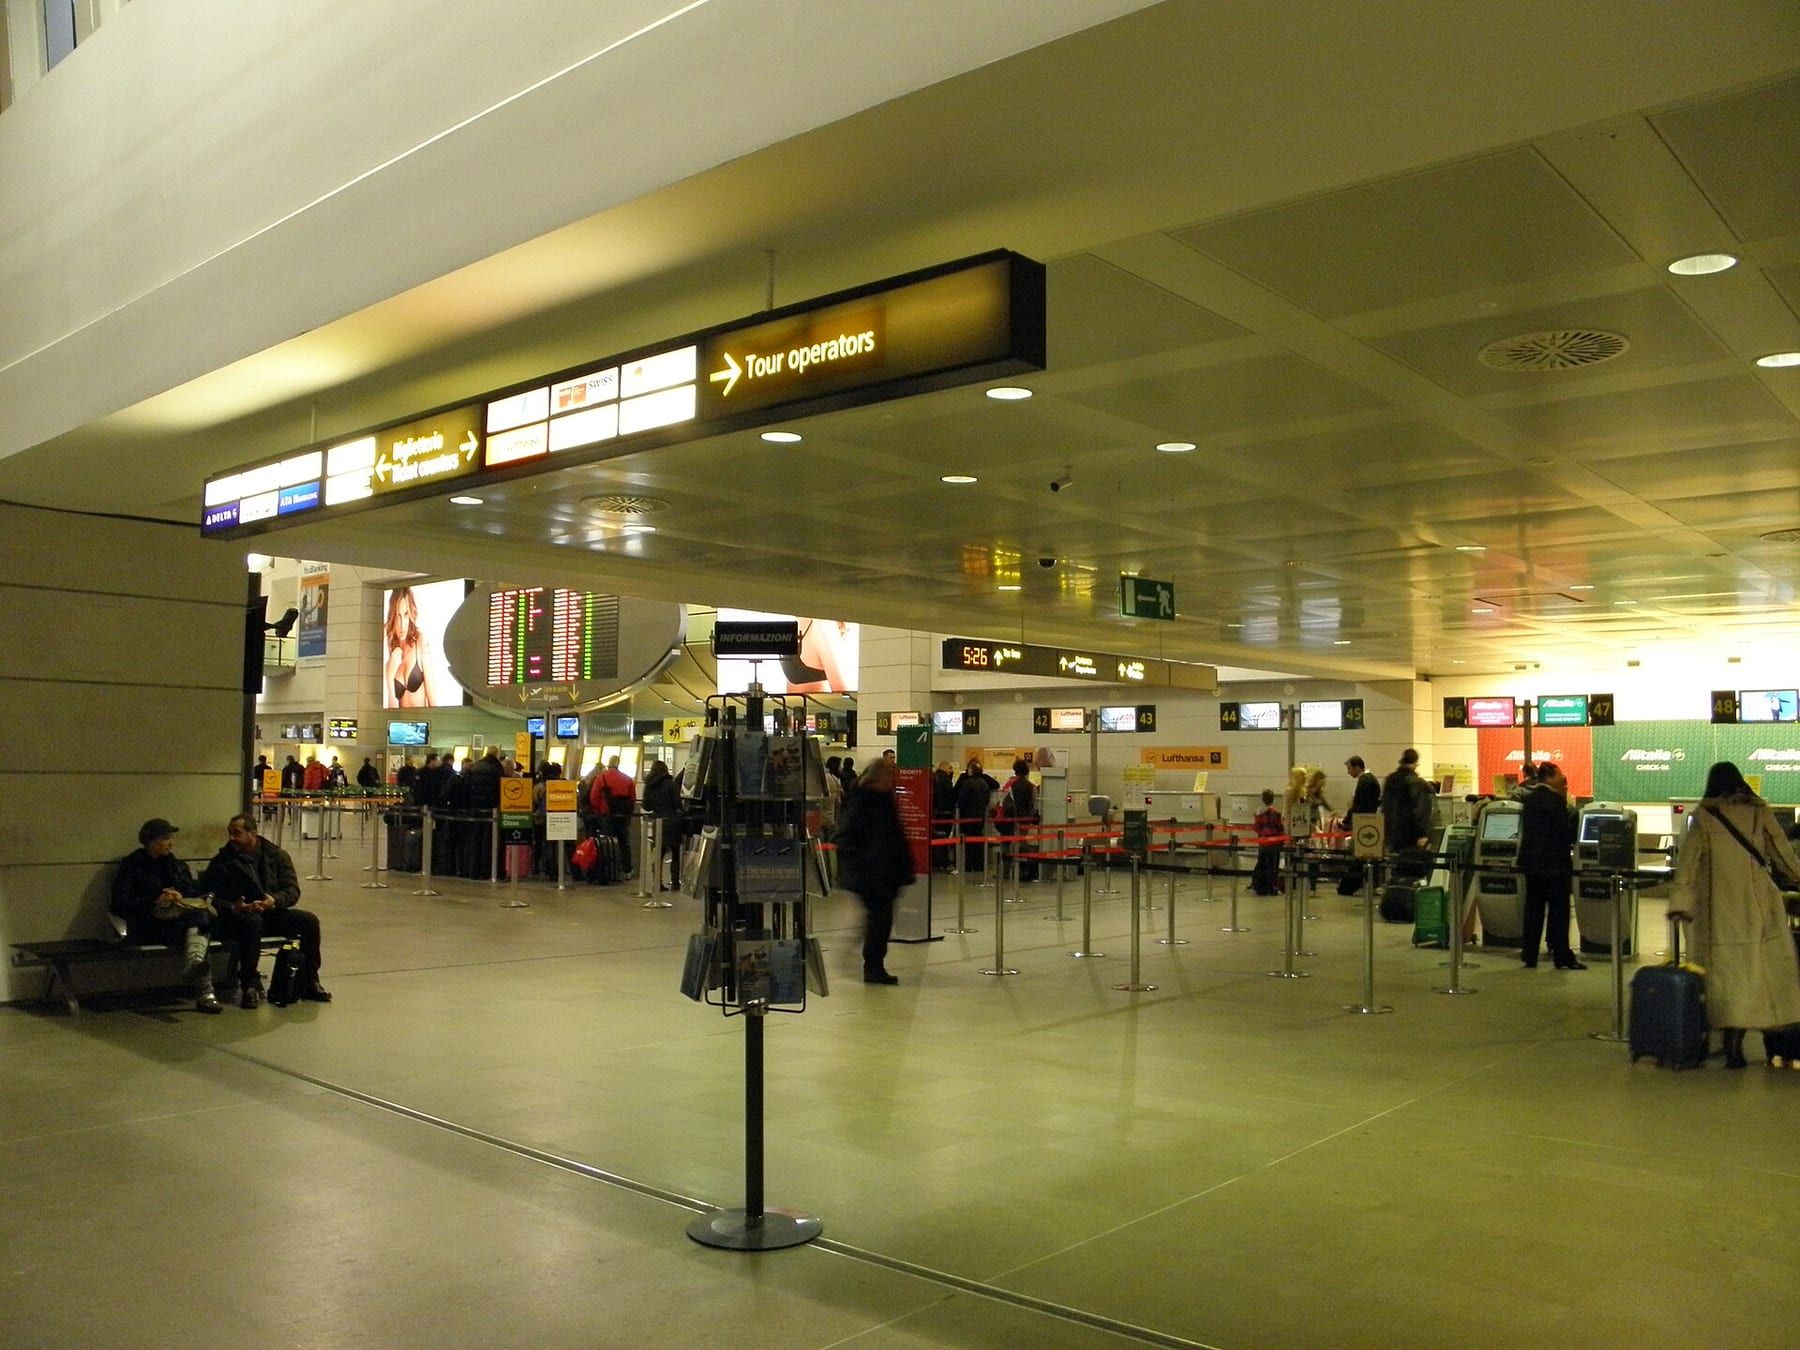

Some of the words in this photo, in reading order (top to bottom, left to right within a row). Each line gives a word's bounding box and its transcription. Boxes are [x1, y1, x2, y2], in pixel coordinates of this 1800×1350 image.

[744, 352, 785, 380] Tour
[787, 330, 876, 374] operators
[211, 509, 232, 524] DELTA
[720, 633, 794, 643] INFORMAZIONI
[963, 646, 988, 666] 5:26
[1447, 705, 1463, 719] 46
[1593, 703, 1611, 716] 47
[1713, 699, 1734, 714] 48
[1035, 715, 1048, 727] 42
[1139, 712, 1153, 725] 43
[1221, 710, 1237, 723] 44
[1346, 708, 1361, 721] 45
[818, 718, 828, 729] 39
[878, 718, 889, 729] 40
[966, 716, 977, 727] 41
[1161, 752, 1205, 763] Lufthansa
